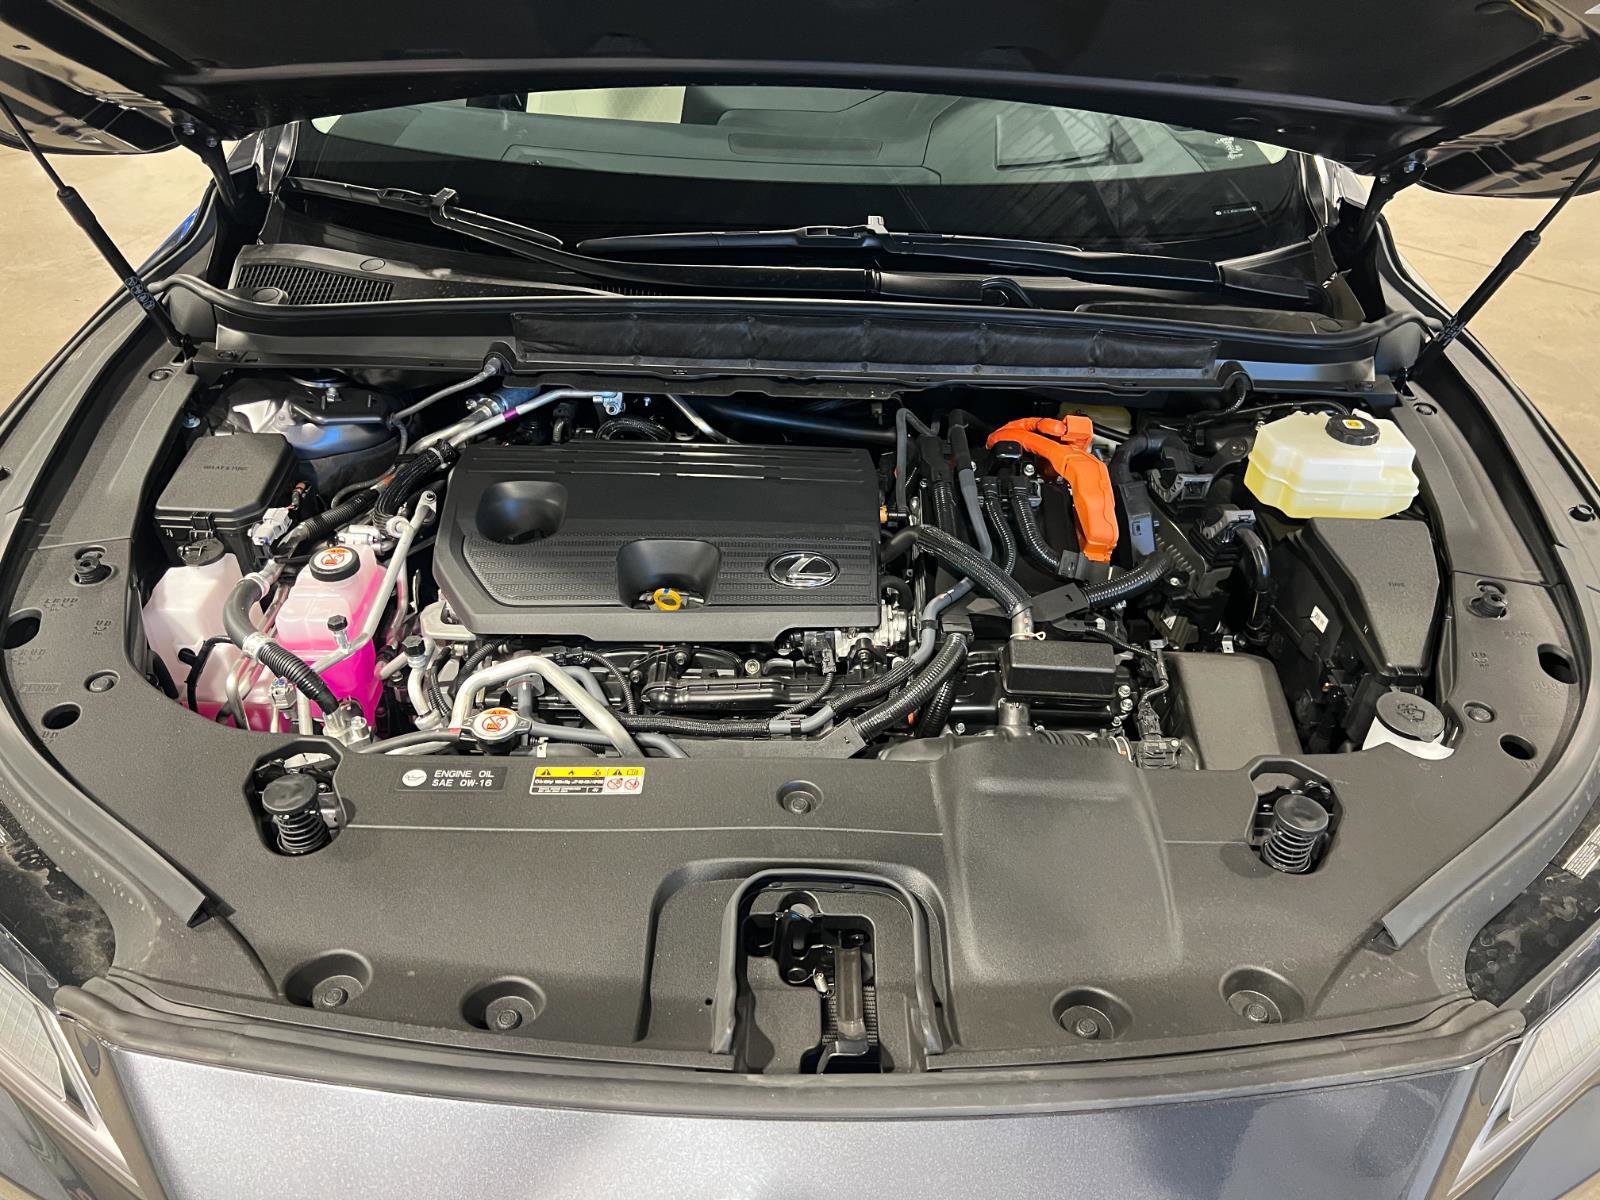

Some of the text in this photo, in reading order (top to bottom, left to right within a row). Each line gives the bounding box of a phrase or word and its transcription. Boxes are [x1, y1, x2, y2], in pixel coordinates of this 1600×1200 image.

[434, 769, 495, 778] ENGINE OIL
[431, 778, 454, 787] SAE
